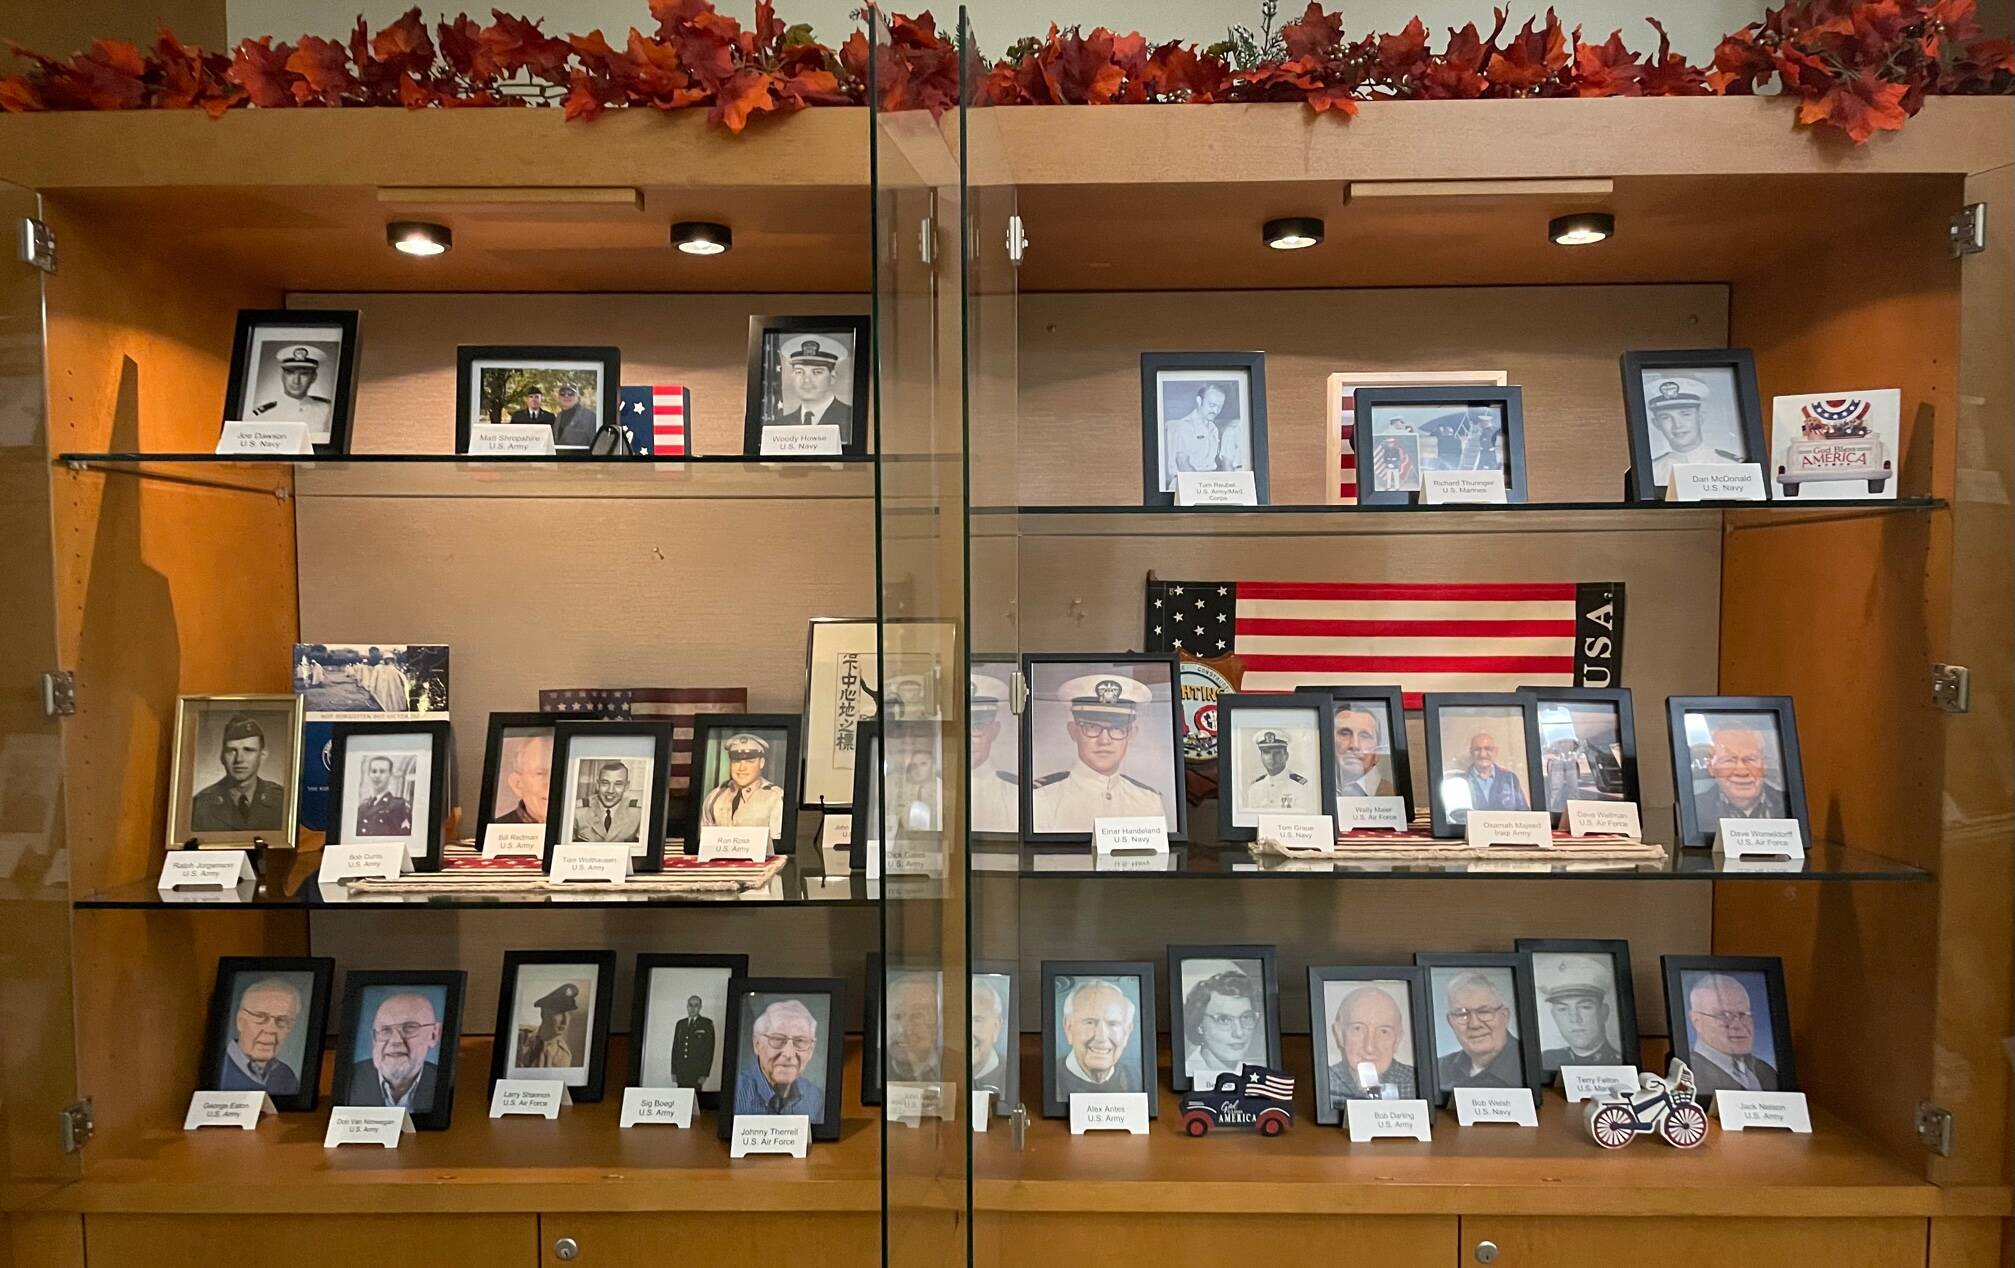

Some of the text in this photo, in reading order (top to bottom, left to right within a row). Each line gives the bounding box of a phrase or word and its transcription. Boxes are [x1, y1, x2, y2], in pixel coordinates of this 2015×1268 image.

[237, 432, 250, 440] Joe
[498, 434, 540, 442] Shropshire
[772, 435, 798, 443] Woody
[509, 443, 529, 451] Army
[1812, 446, 1832, 454] God
[1802, 452, 1866, 468] AMERICA
[1692, 475, 1709, 483] Dan
[1722, 485, 1744, 493] Navy
[1131, 836, 1150, 844] Navy
[516, 842, 534, 850] Army
[732, 846, 750, 854] Army
[588, 864, 605, 872] Army
[503, 1091, 520, 1099] Larry
[202, 1102, 228, 1110] George
[640, 1100, 653, 1108] Sig
[1087, 1105, 1103, 1113] Alex
[1492, 1109, 1511, 1117] Navy
[656, 1109, 675, 1118] Army
[1219, 1113, 1257, 1122] AMERICA
[1744, 1112, 1784, 1121] U.S. Army
[1105, 1115, 1125, 1123] Army
[1395, 1121, 1413, 1129] Army
[741, 1128, 768, 1137] Johnny
[742, 1138, 758, 1146] U.S.
